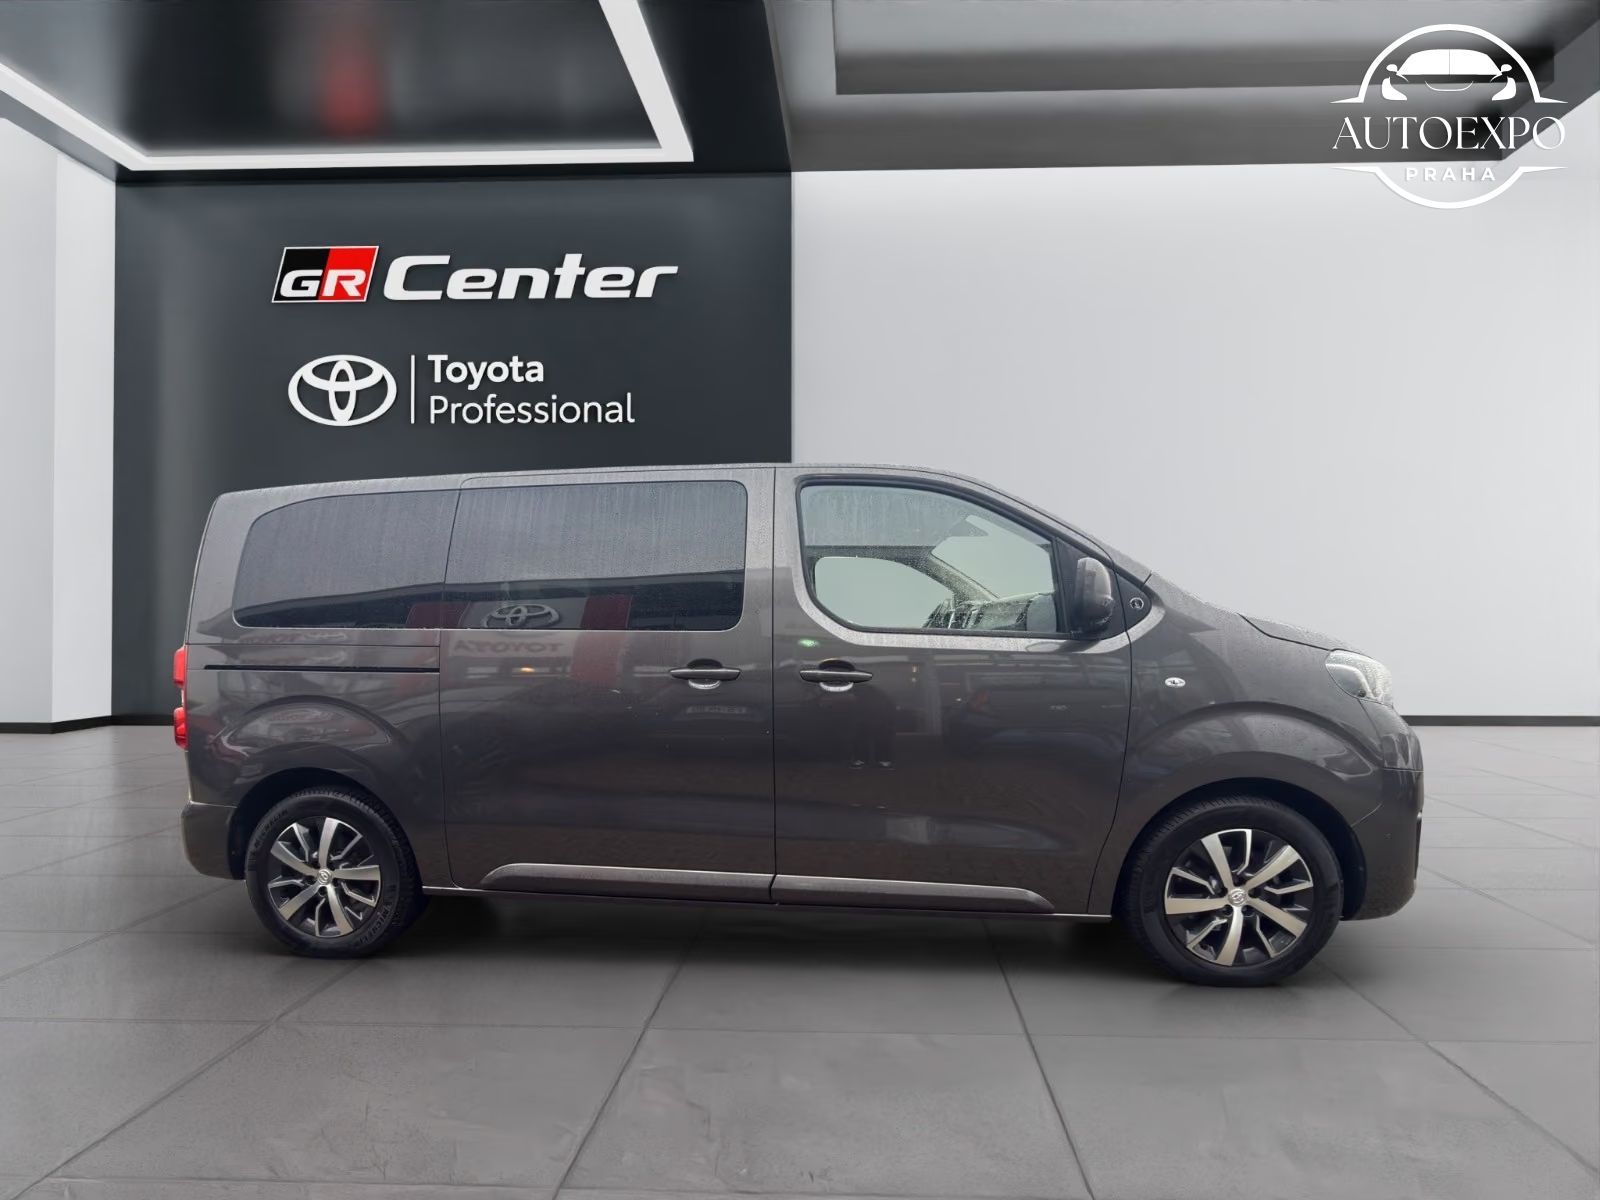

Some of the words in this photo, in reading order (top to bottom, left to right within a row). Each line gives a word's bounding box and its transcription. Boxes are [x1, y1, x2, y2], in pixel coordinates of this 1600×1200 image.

[280, 269, 366, 297] GR
[384, 253, 679, 300] Center
[428, 354, 545, 390] Toyota
[430, 393, 635, 424] Professional
